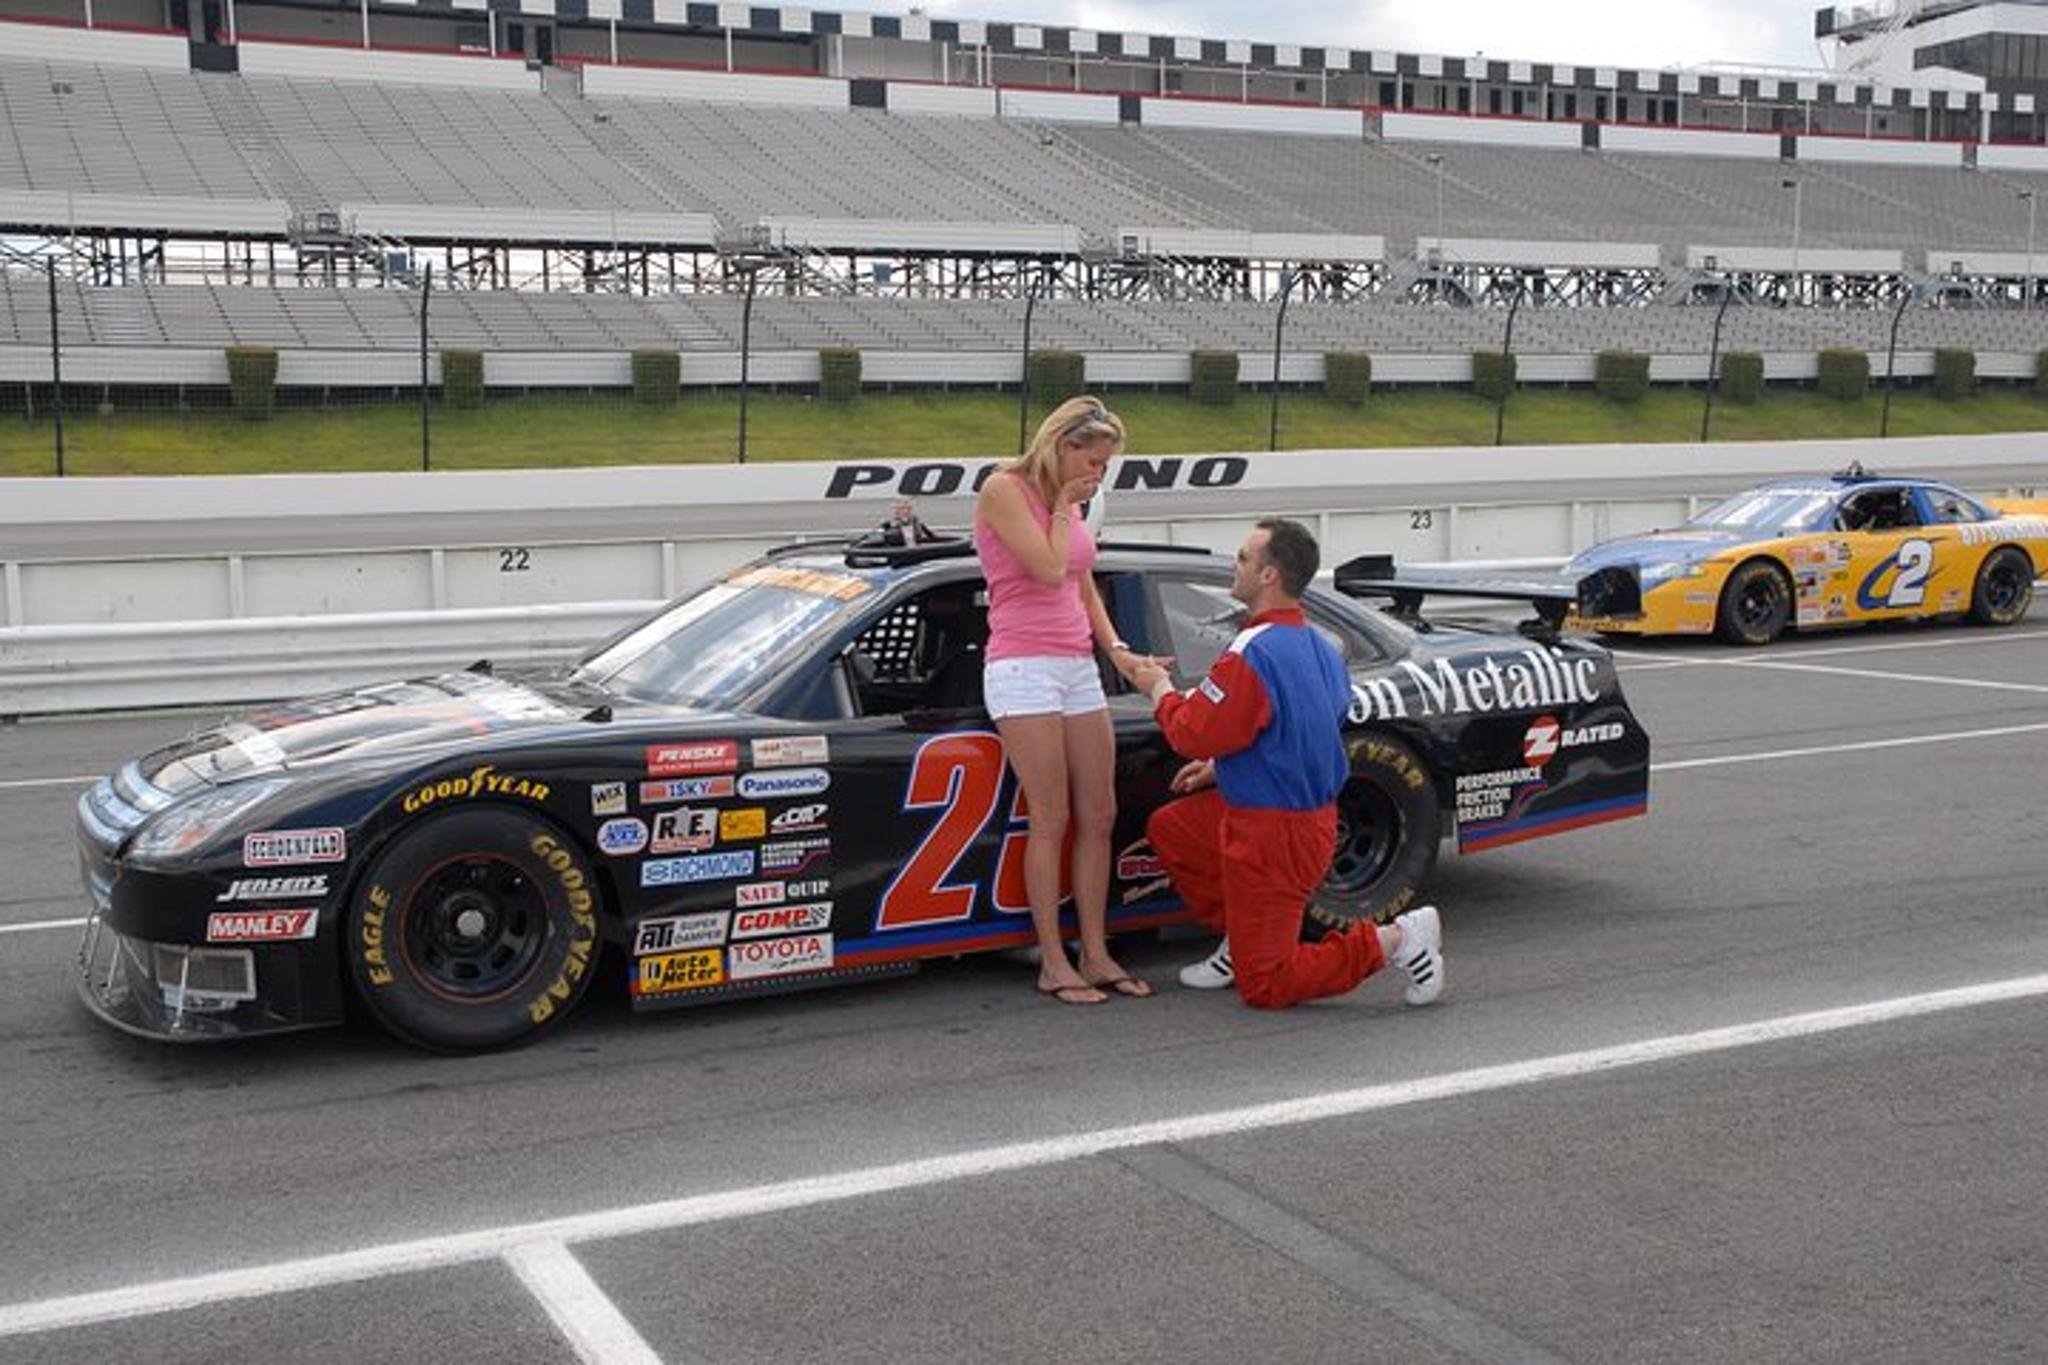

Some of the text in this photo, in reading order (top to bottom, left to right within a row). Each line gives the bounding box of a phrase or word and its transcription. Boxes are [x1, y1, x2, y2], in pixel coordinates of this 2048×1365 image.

[825, 456, 1249, 499] PONO
[1410, 509, 1432, 530] 23
[500, 548, 530, 572] 22
[1886, 539, 1934, 606] 2
[1398, 649, 1599, 714] Metallic
[1523, 722, 1625, 759] Z RATED
[403, 765, 550, 812] GOODYEAR
[744, 773, 826, 792] Panasonic
[1455, 768, 1542, 791] PERFORMANCE
[670, 854, 752, 881] RICHMOND
[211, 914, 300, 937] MANLEY
[528, 834, 597, 1024] GOODYEAR
[738, 908, 810, 931] COMP
[361, 885, 393, 986] EAGLE
[733, 937, 823, 962] TOYOTA
[664, 955, 711, 970] Auto
[662, 967, 719, 986] Meter
